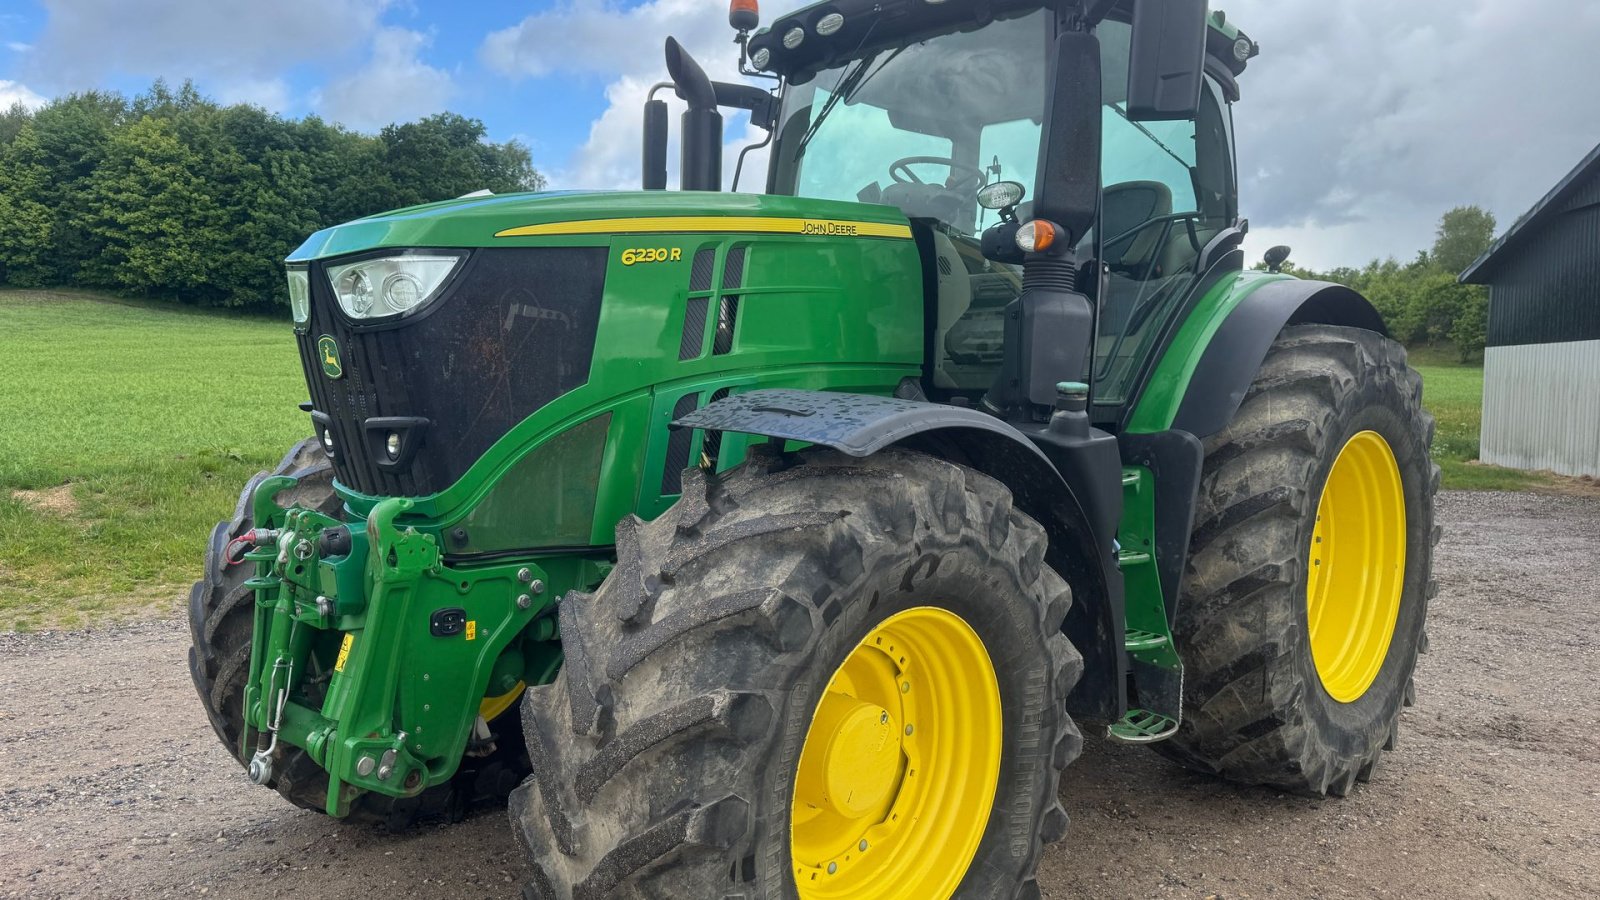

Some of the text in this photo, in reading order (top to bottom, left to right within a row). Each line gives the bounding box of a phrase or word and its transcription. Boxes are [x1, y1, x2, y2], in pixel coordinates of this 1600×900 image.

[622, 247, 682, 266] 6230 R
[801, 221, 857, 235] JOHN DEERE
[764, 682, 810, 900] RELLEBORG
[1009, 664, 1048, 857] TRELLEBORG
